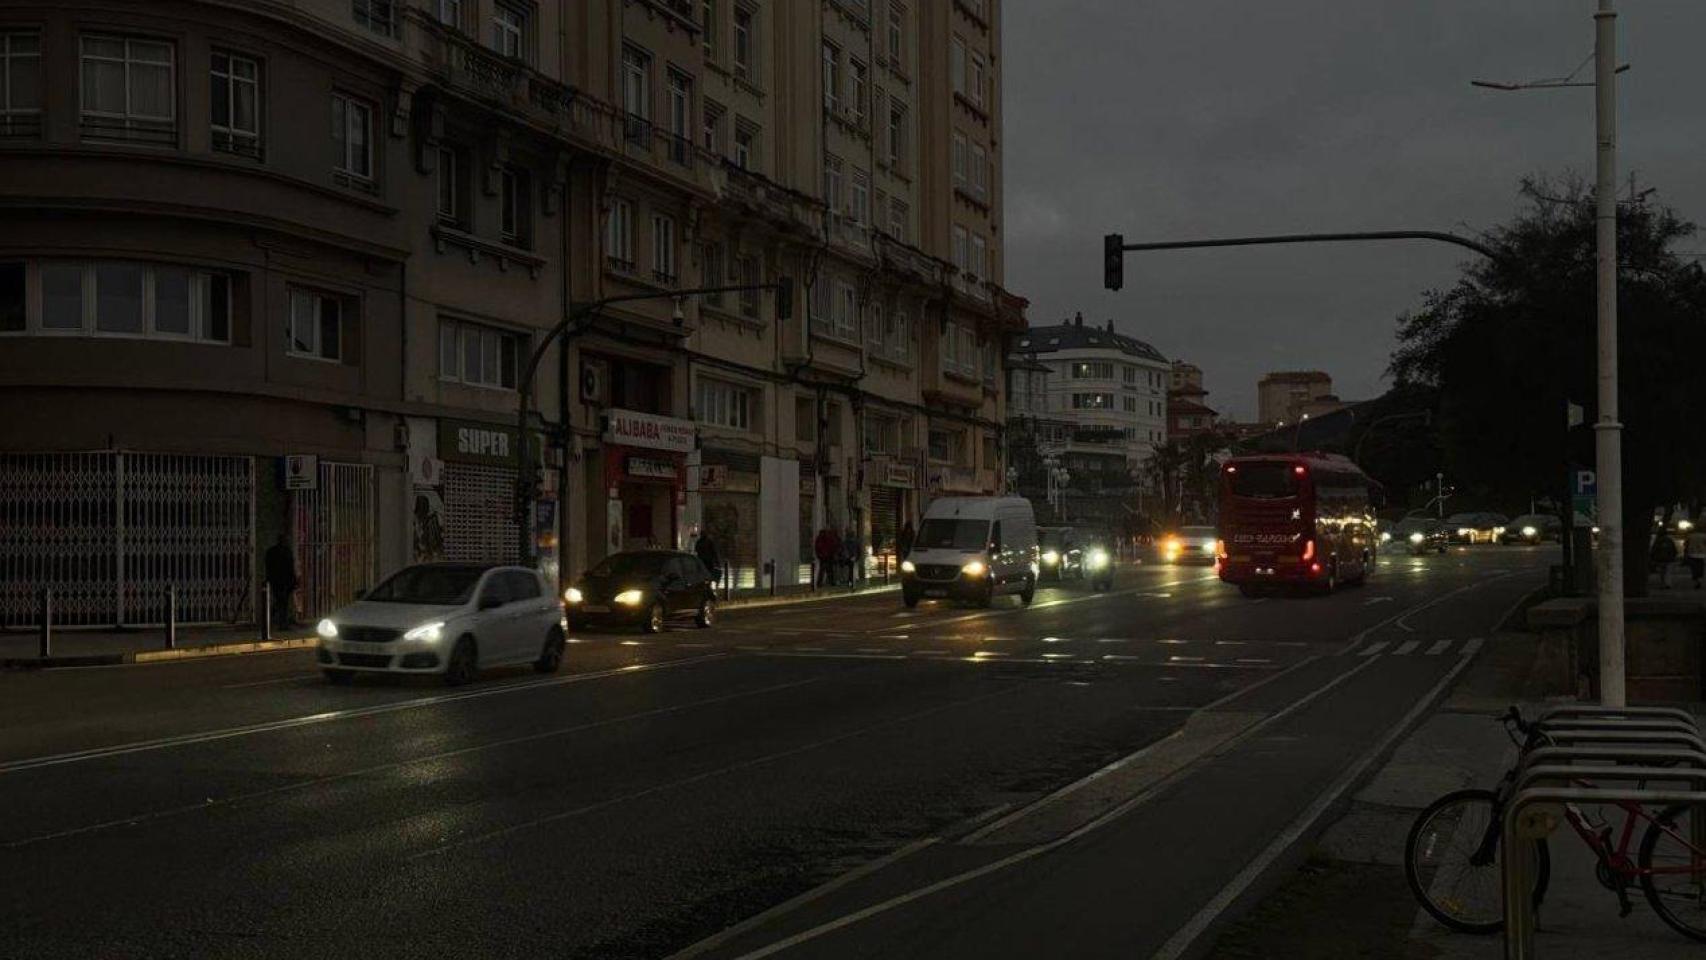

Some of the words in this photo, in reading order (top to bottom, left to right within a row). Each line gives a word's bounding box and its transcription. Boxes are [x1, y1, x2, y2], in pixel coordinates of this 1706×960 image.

[615, 418, 660, 440] ALIBABA
[458, 428, 509, 457] SUPER
[1577, 471, 1595, 496] P
